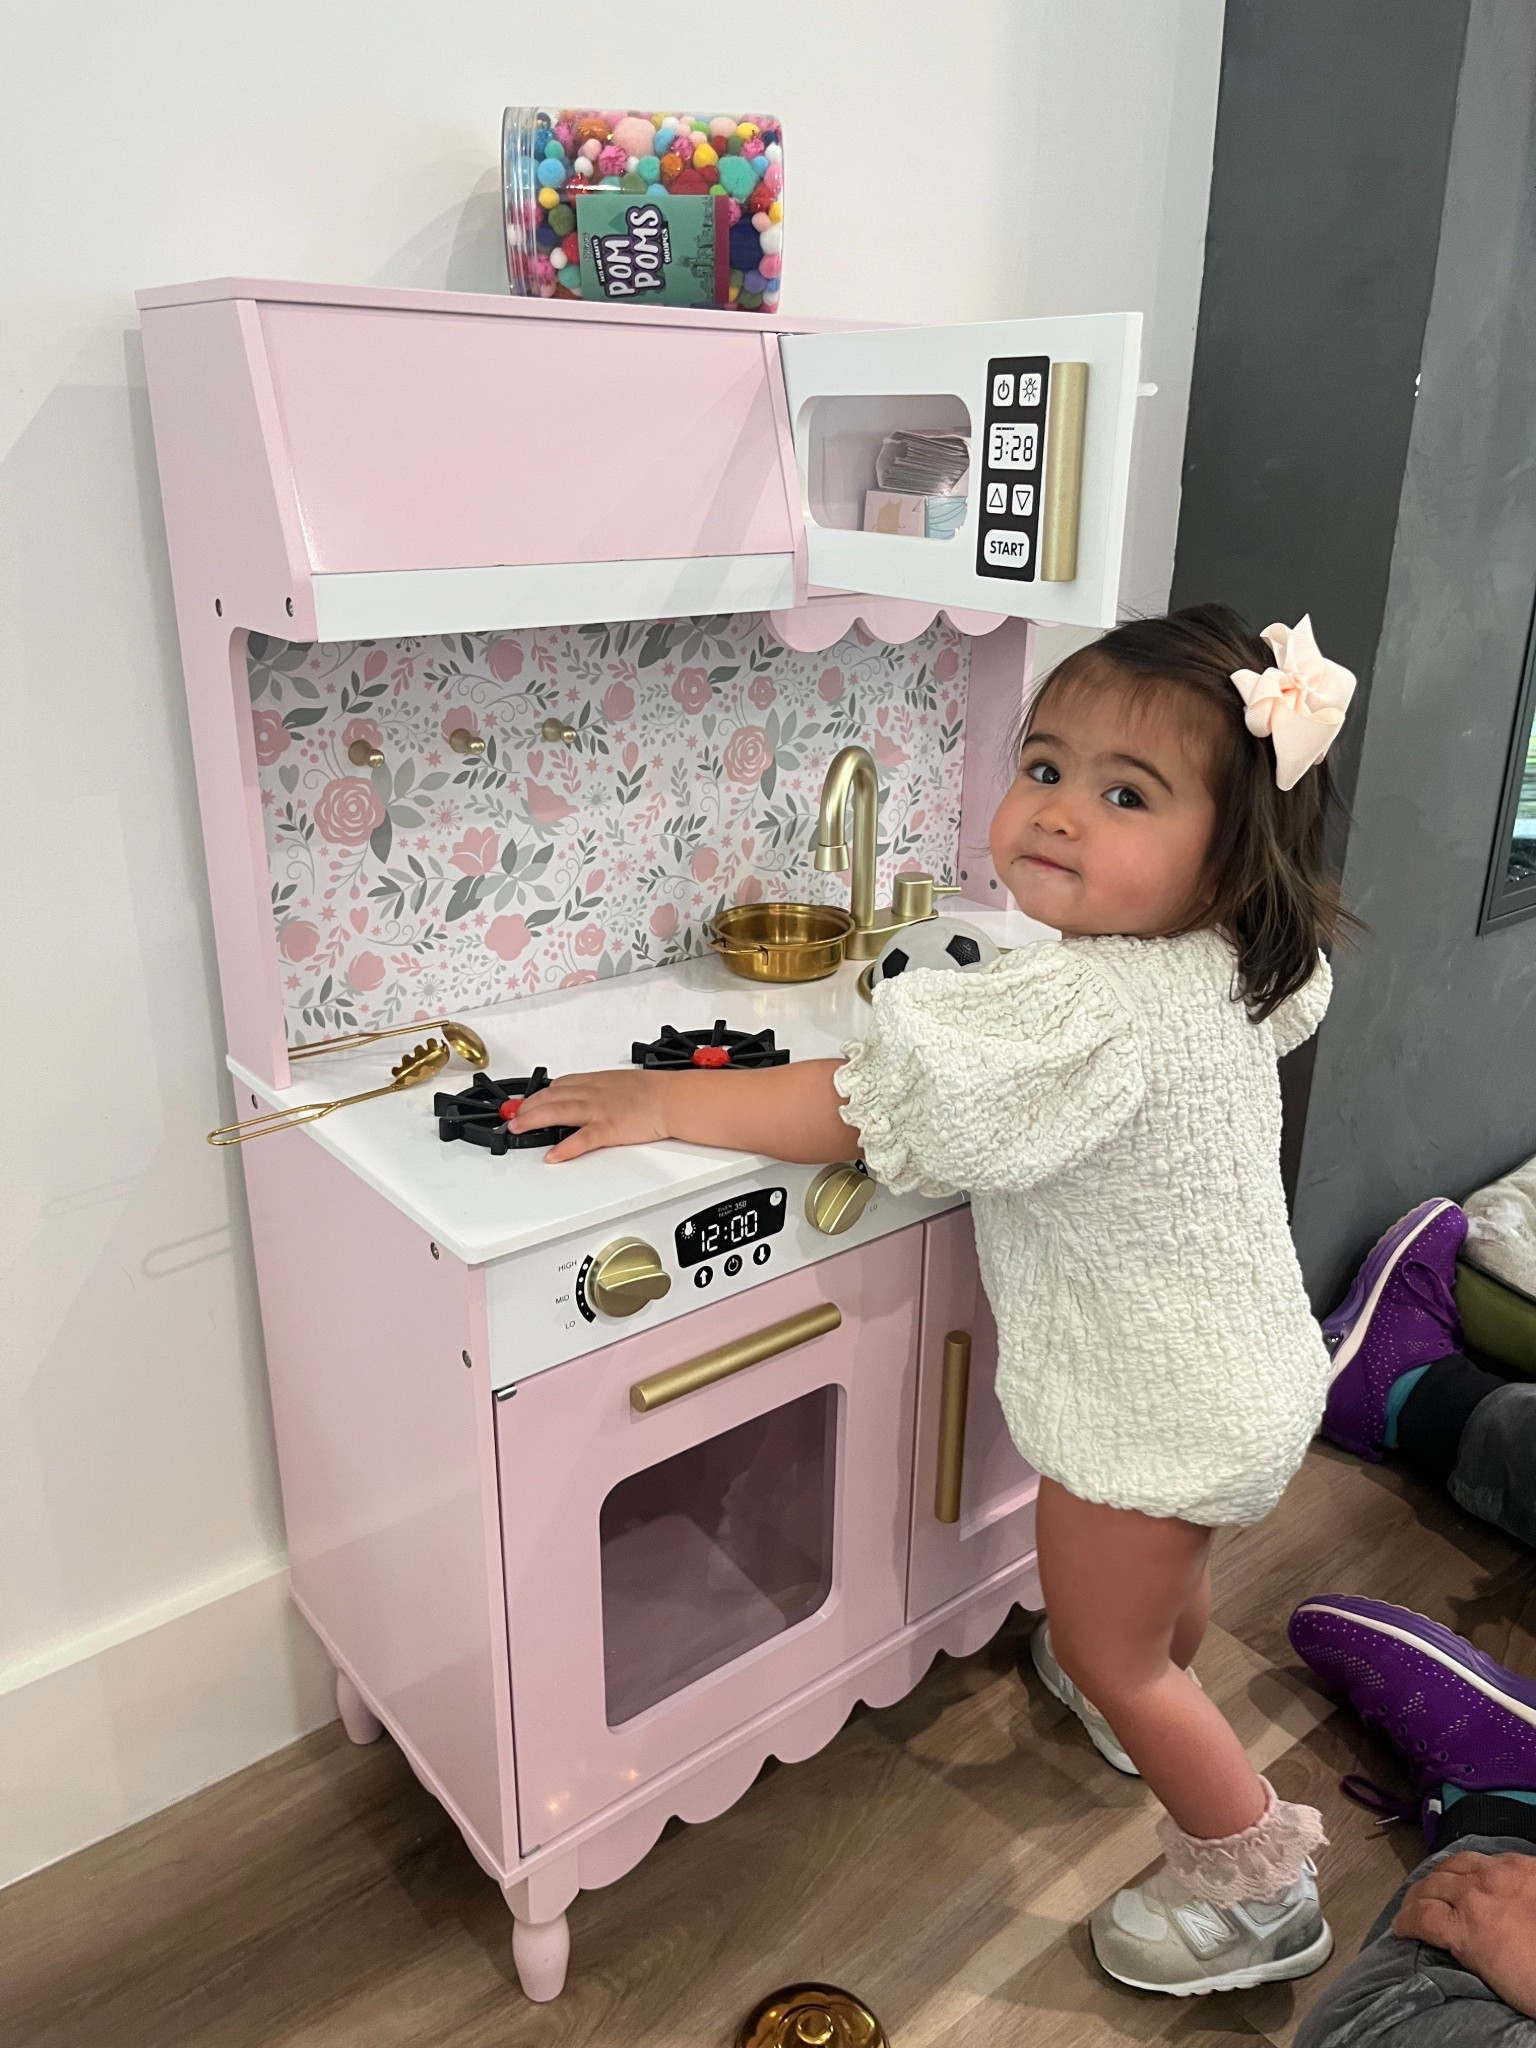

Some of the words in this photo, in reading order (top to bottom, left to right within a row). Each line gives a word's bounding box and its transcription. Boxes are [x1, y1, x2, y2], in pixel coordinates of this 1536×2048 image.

[630, 209, 661, 288] POMS
[604, 240, 635, 295] POM
[993, 435, 1034, 462] 3:28
[989, 540, 1025, 557] START
[734, 1200, 747, 1211] 350
[869, 1204, 878, 1212] LO
[701, 1210, 758, 1252] 12:00
[558, 1260, 577, 1272] HIGH
[555, 1294, 570, 1304] MID
[565, 1320, 576, 1330] LO
